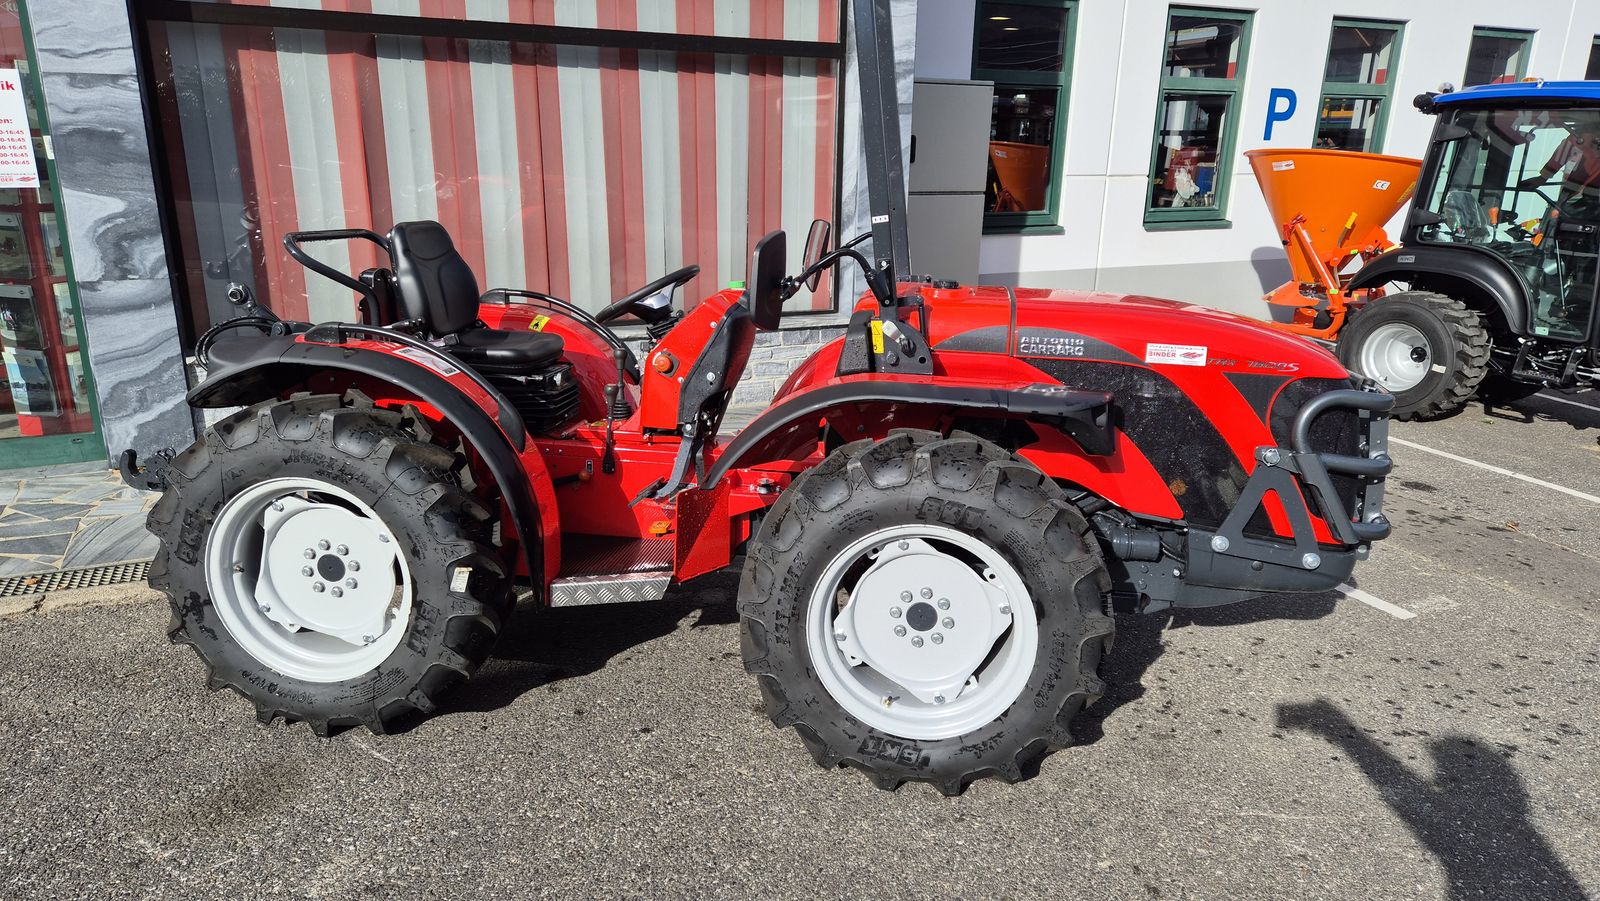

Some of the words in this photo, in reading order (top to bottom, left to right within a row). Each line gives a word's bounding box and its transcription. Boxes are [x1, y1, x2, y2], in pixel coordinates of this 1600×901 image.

[1263, 88, 1297, 141] P
[1020, 336, 1085, 346] ANTONIO
[1020, 343, 1085, 356] CARRARO
[859, 738, 919, 768] BKT
